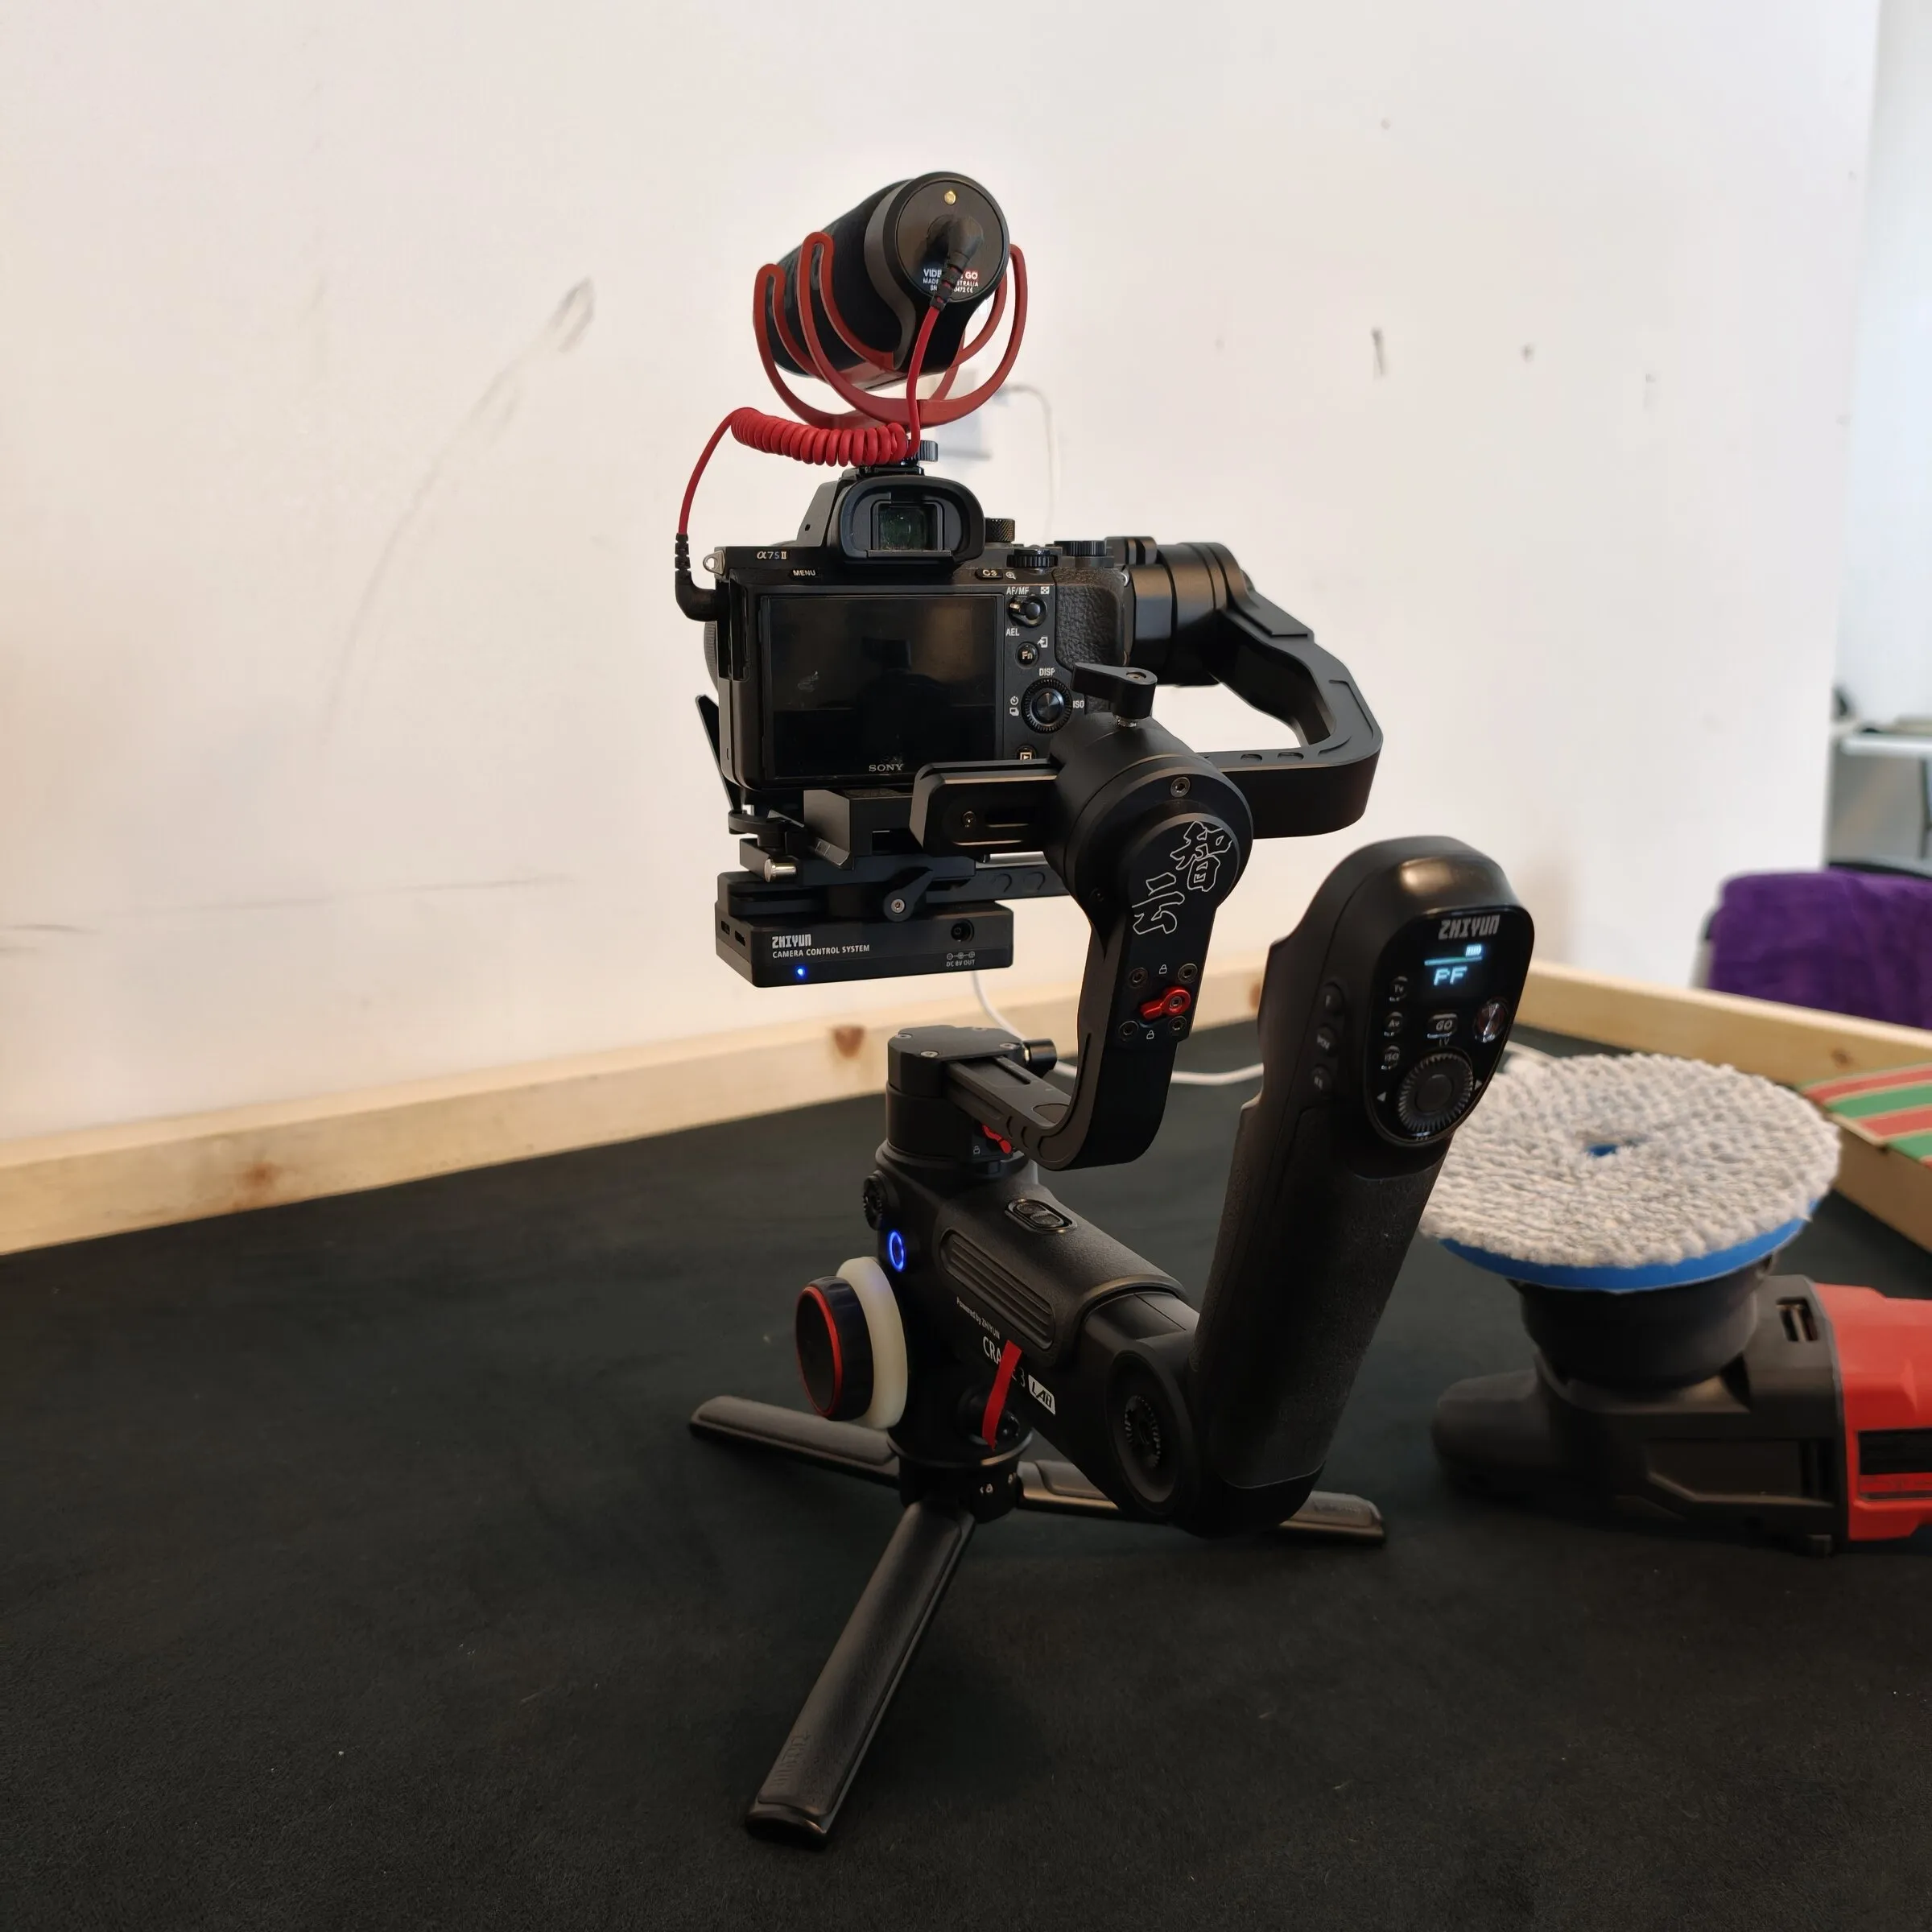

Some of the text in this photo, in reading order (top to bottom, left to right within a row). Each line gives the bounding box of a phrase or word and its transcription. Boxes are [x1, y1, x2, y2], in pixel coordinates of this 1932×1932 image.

[965, 271, 978, 279] GO
[1006, 586, 1030, 595] AF/MF
[1005, 628, 1020, 636] AEL
[1022, 650, 1033, 660] Fn
[1038, 668, 1055, 676] DISP
[1072, 700, 1084, 708] ISO
[869, 764, 903, 772] SONY
[1438, 914, 1501, 940] ZHIYUN
[771, 934, 812, 949] ZHIYUN
[773, 944, 870, 959] CAMERA CONTROL SYSTEM
[1434, 966, 1468, 985] PF
[976, 1313, 981, 1325] by
[981, 1317, 1001, 1340] ZHIYUN
[1031, 1379, 1053, 1410] LAB
